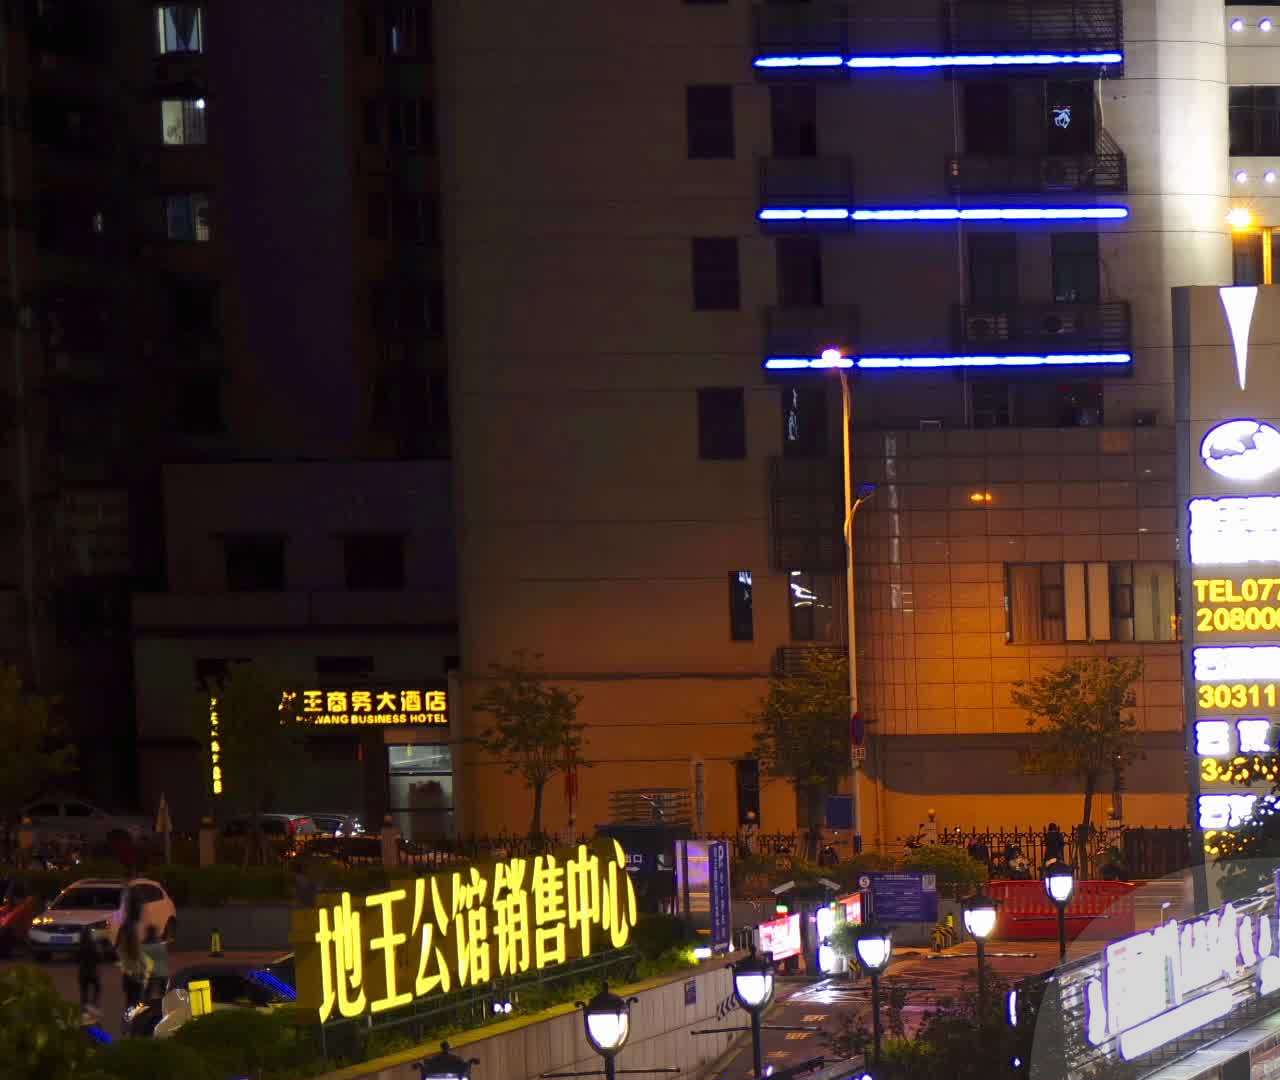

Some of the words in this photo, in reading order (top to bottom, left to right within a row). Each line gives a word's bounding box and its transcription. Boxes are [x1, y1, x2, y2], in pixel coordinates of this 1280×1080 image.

[277, 690, 448, 713] 王商务大酒店
[350, 713, 407, 725] BUSINESS
[409, 712, 448, 724] HOTEL
[316, 838, 638, 1024] 地王公馆销售中心
